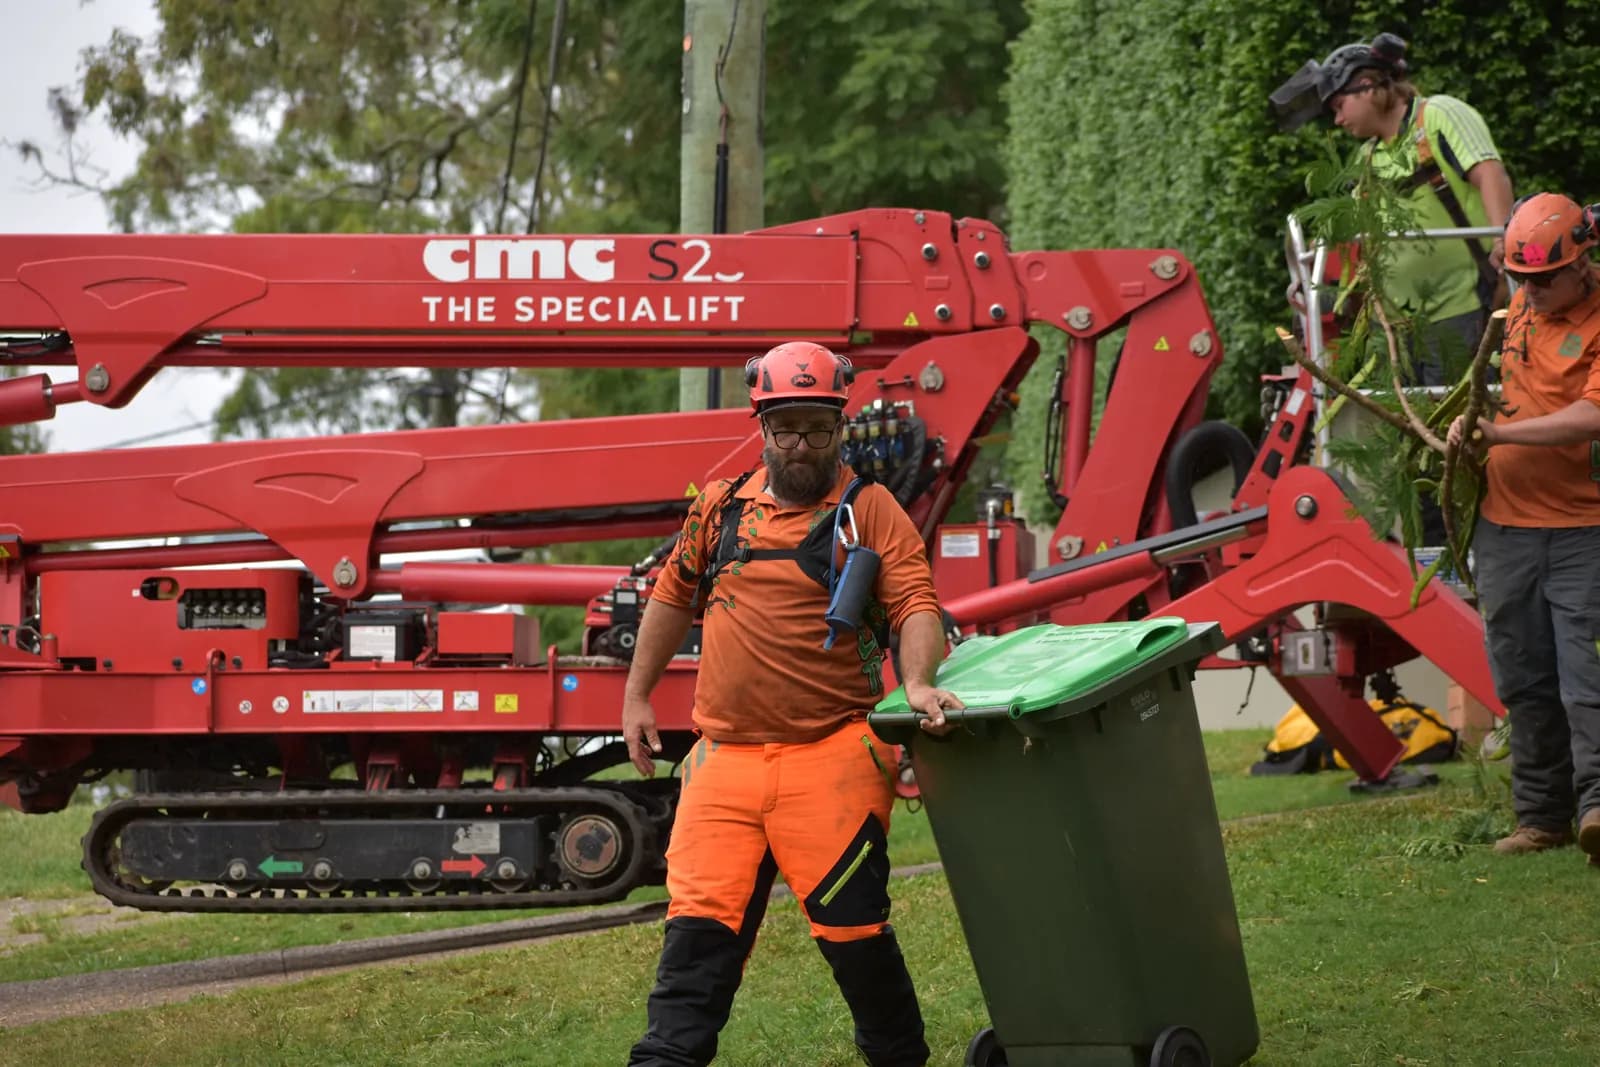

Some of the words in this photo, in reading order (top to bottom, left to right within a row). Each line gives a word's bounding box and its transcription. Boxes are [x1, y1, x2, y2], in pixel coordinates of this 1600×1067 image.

[648, 239, 744, 282] S2
[422, 296, 496, 321] THE
[514, 296, 745, 321] SPECIALIFT
